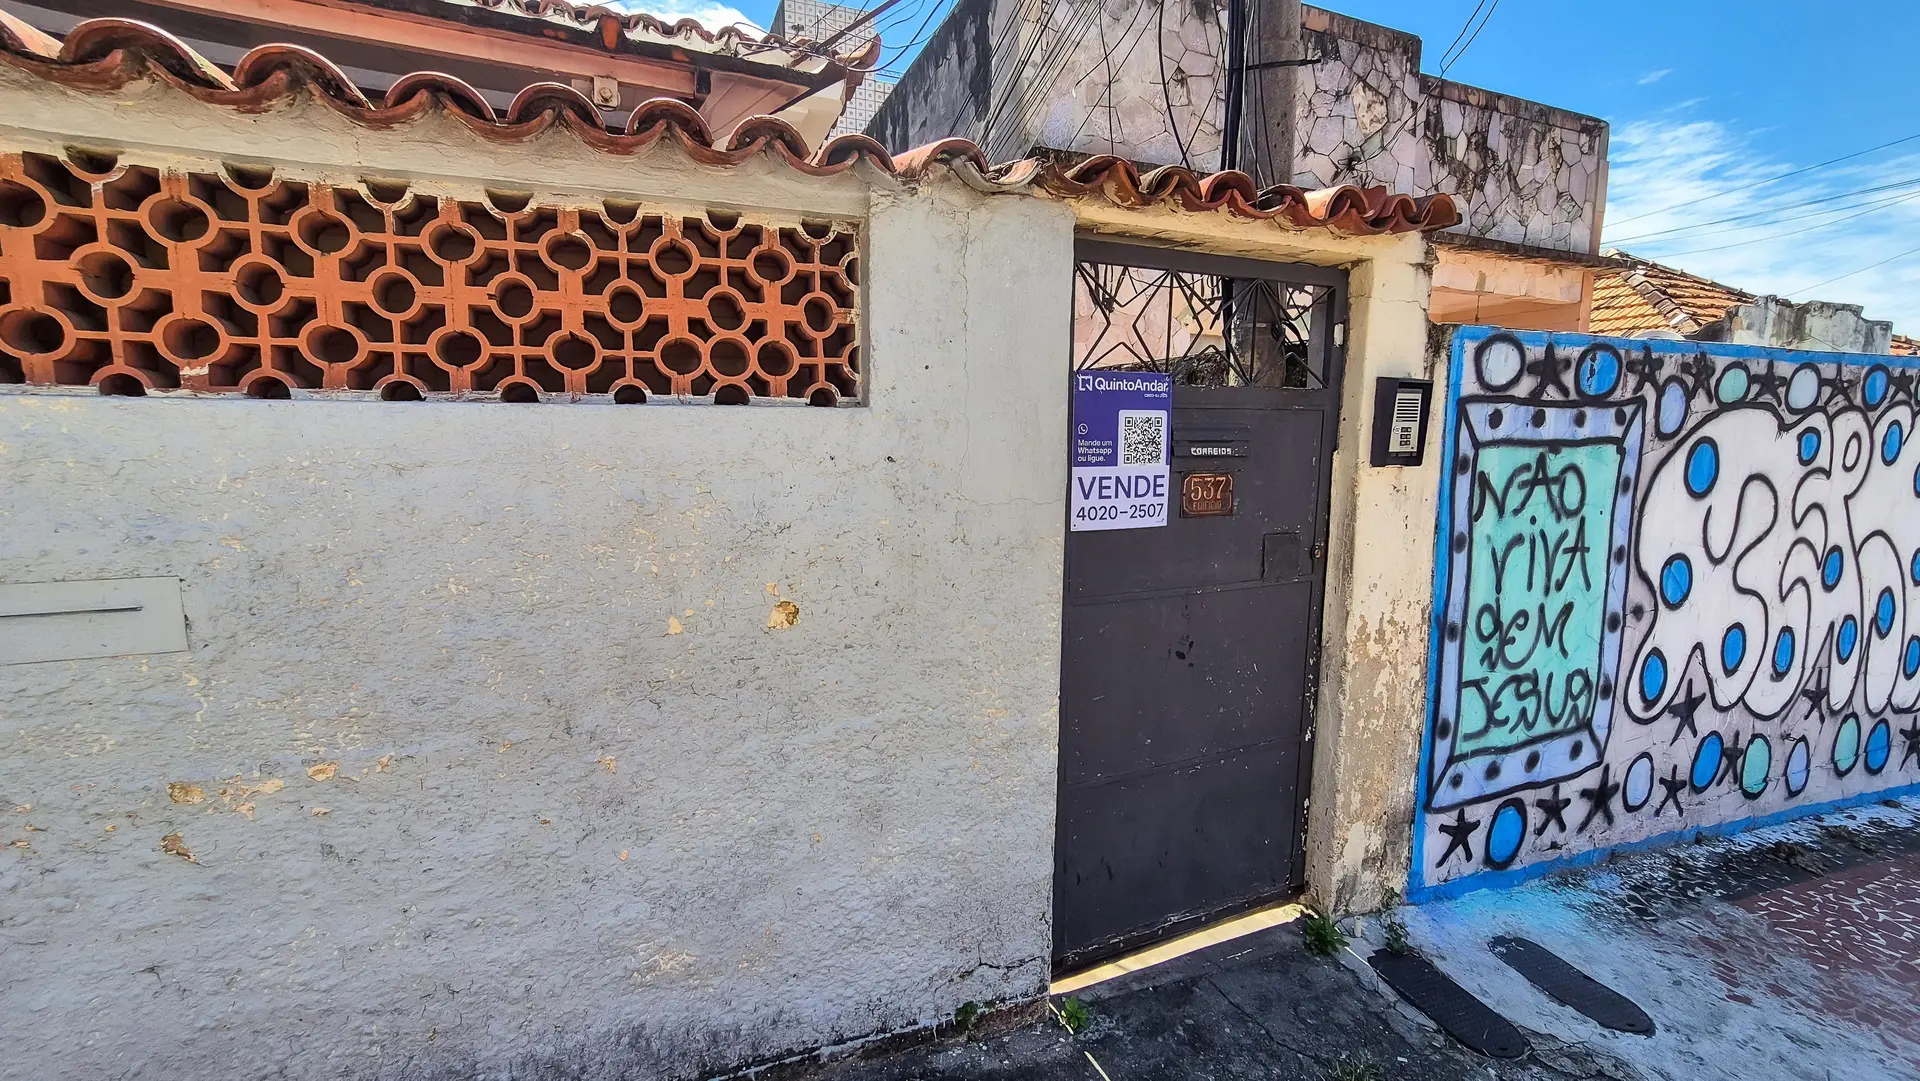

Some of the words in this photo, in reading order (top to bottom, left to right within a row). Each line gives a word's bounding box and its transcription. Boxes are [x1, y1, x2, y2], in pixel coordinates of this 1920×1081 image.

[1094, 377, 1168, 393] QuintoAndar
[1077, 446, 1112, 455] Whatsapp
[1087, 454, 1106, 463] ligue.
[1077, 474, 1166, 500] VENDE
[1190, 476, 1226, 501] 537
[1076, 502, 1164, 521] 4020-2507
